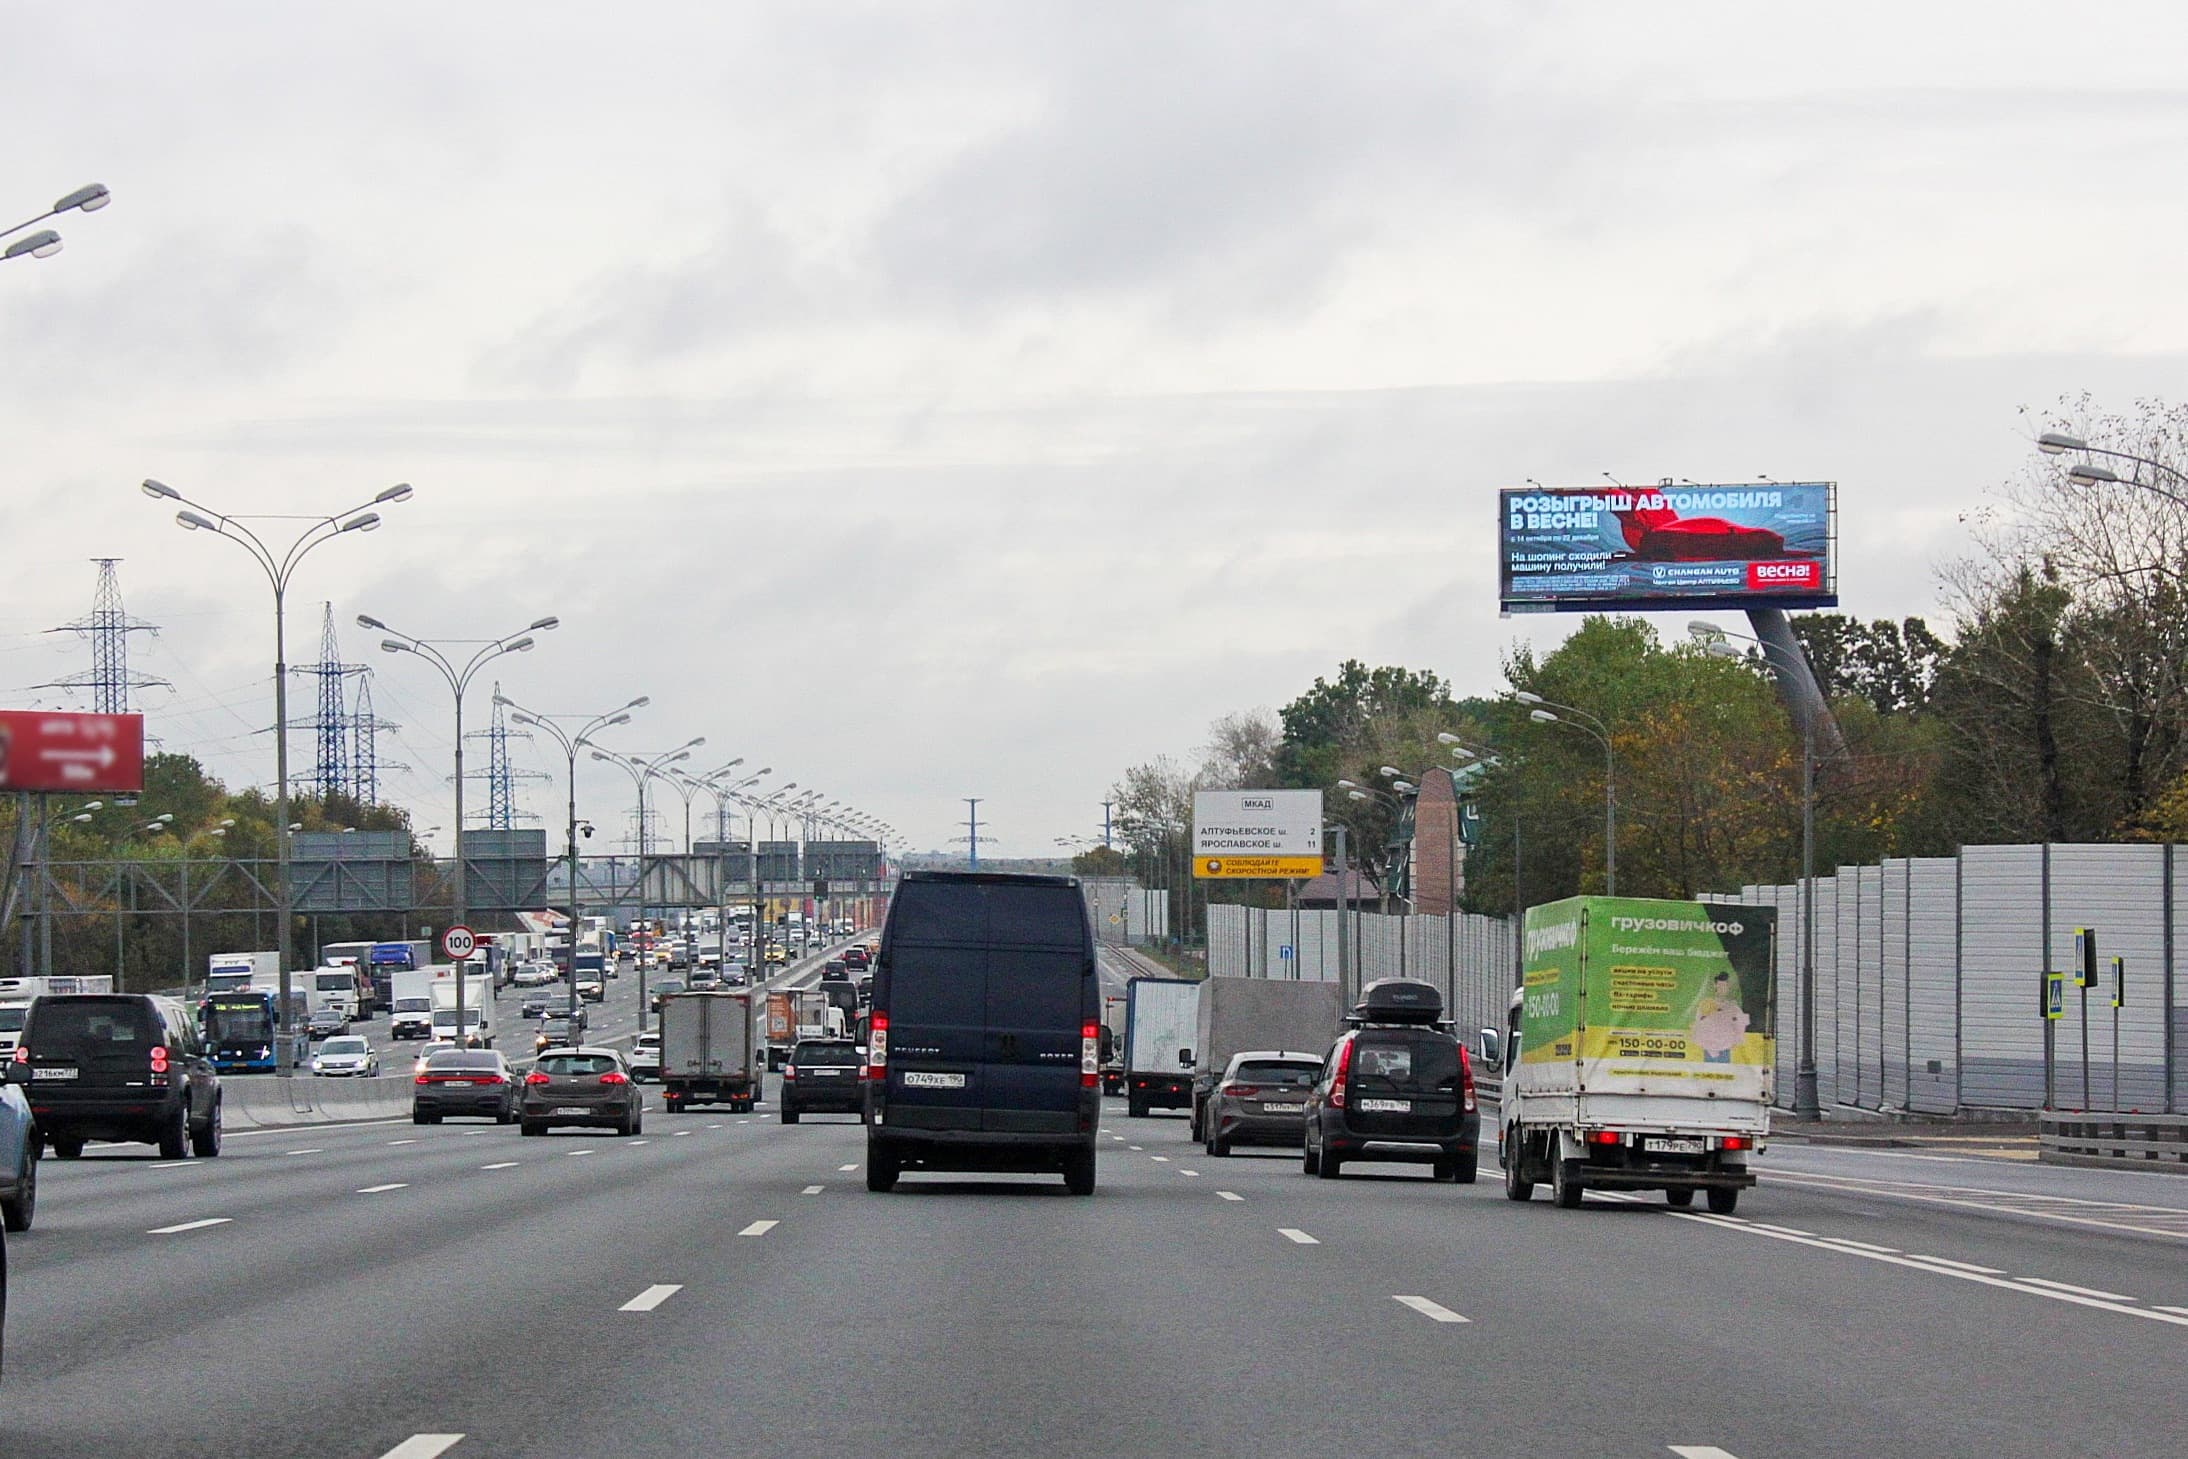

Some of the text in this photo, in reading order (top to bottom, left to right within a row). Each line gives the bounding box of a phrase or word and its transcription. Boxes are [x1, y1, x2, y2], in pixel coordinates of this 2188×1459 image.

[1510, 491, 1782, 513] РОЗЫГРЫШ АВТОМОБИЛЯ
[1510, 512, 1598, 530] В ВЕСНЕ!
[1511, 552, 1525, 562] На
[1528, 553, 1567, 562] шопинг
[1568, 552, 1612, 562] сходили
[1511, 560, 1606, 573] машину получили!
[1667, 567, 1740, 576] CHANGAN AUTO
[1244, 800, 1271, 809] МКАД
[1200, 827, 1276, 836] АЛТУФЬЕВСКОЕ
[1310, 828, 1316, 836] 2
[1200, 840, 1271, 849] ЯРОСЛАВСКОЕ
[1307, 840, 1316, 849] 11
[1225, 859, 1279, 867] СОБЛЮДАЙТЕ
[449, 936, 472, 949] 100
[1620, 1038, 1686, 1050] 150-00-00
[894, 1047, 940, 1055] PEUGEOT
